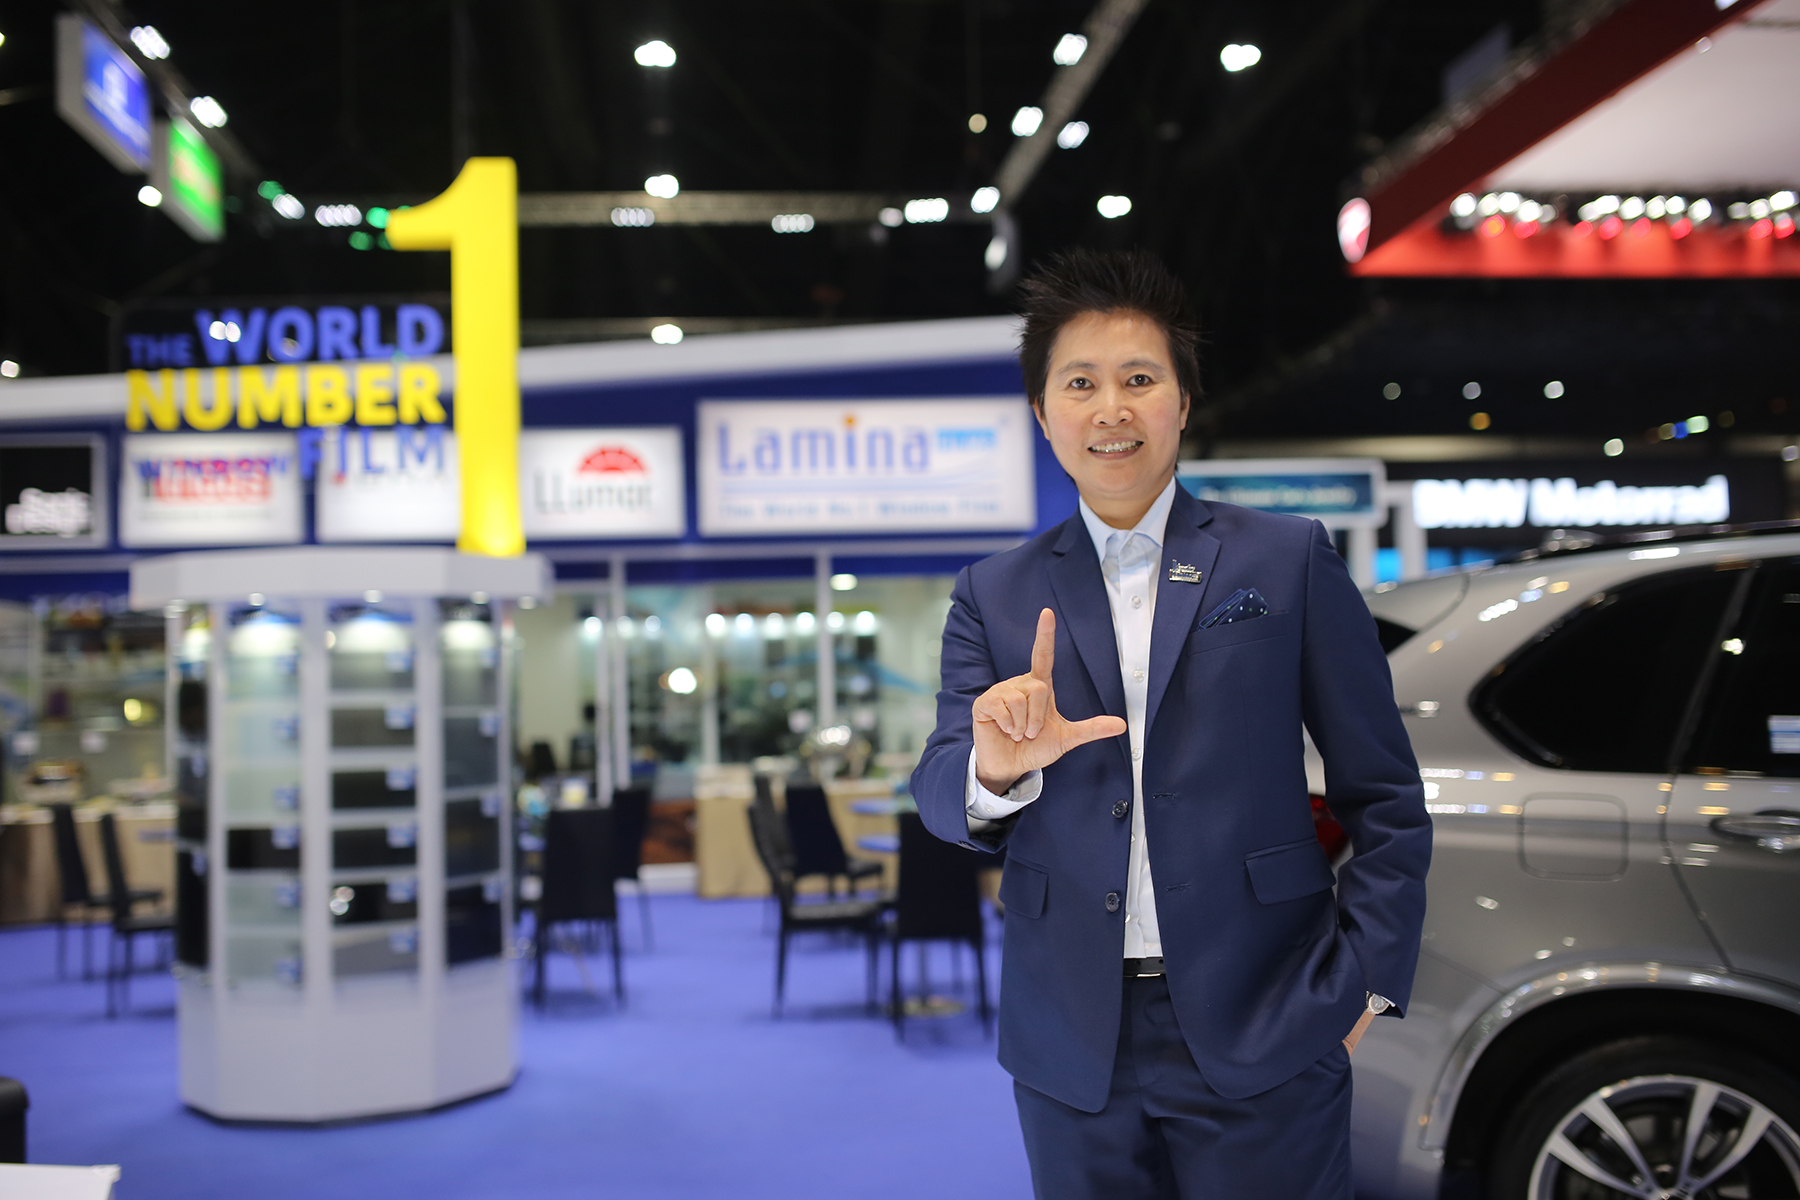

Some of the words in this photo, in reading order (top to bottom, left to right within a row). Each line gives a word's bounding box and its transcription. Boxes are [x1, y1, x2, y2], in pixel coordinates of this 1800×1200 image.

[128, 333, 193, 367] THE
[196, 304, 444, 364] WORLD
[125, 363, 447, 431] NUMBER
[297, 425, 444, 479] FILM
[718, 412, 931, 476] Lamina
[1412, 478, 1528, 529] BMW
[1529, 474, 1729, 527] Motorrad
